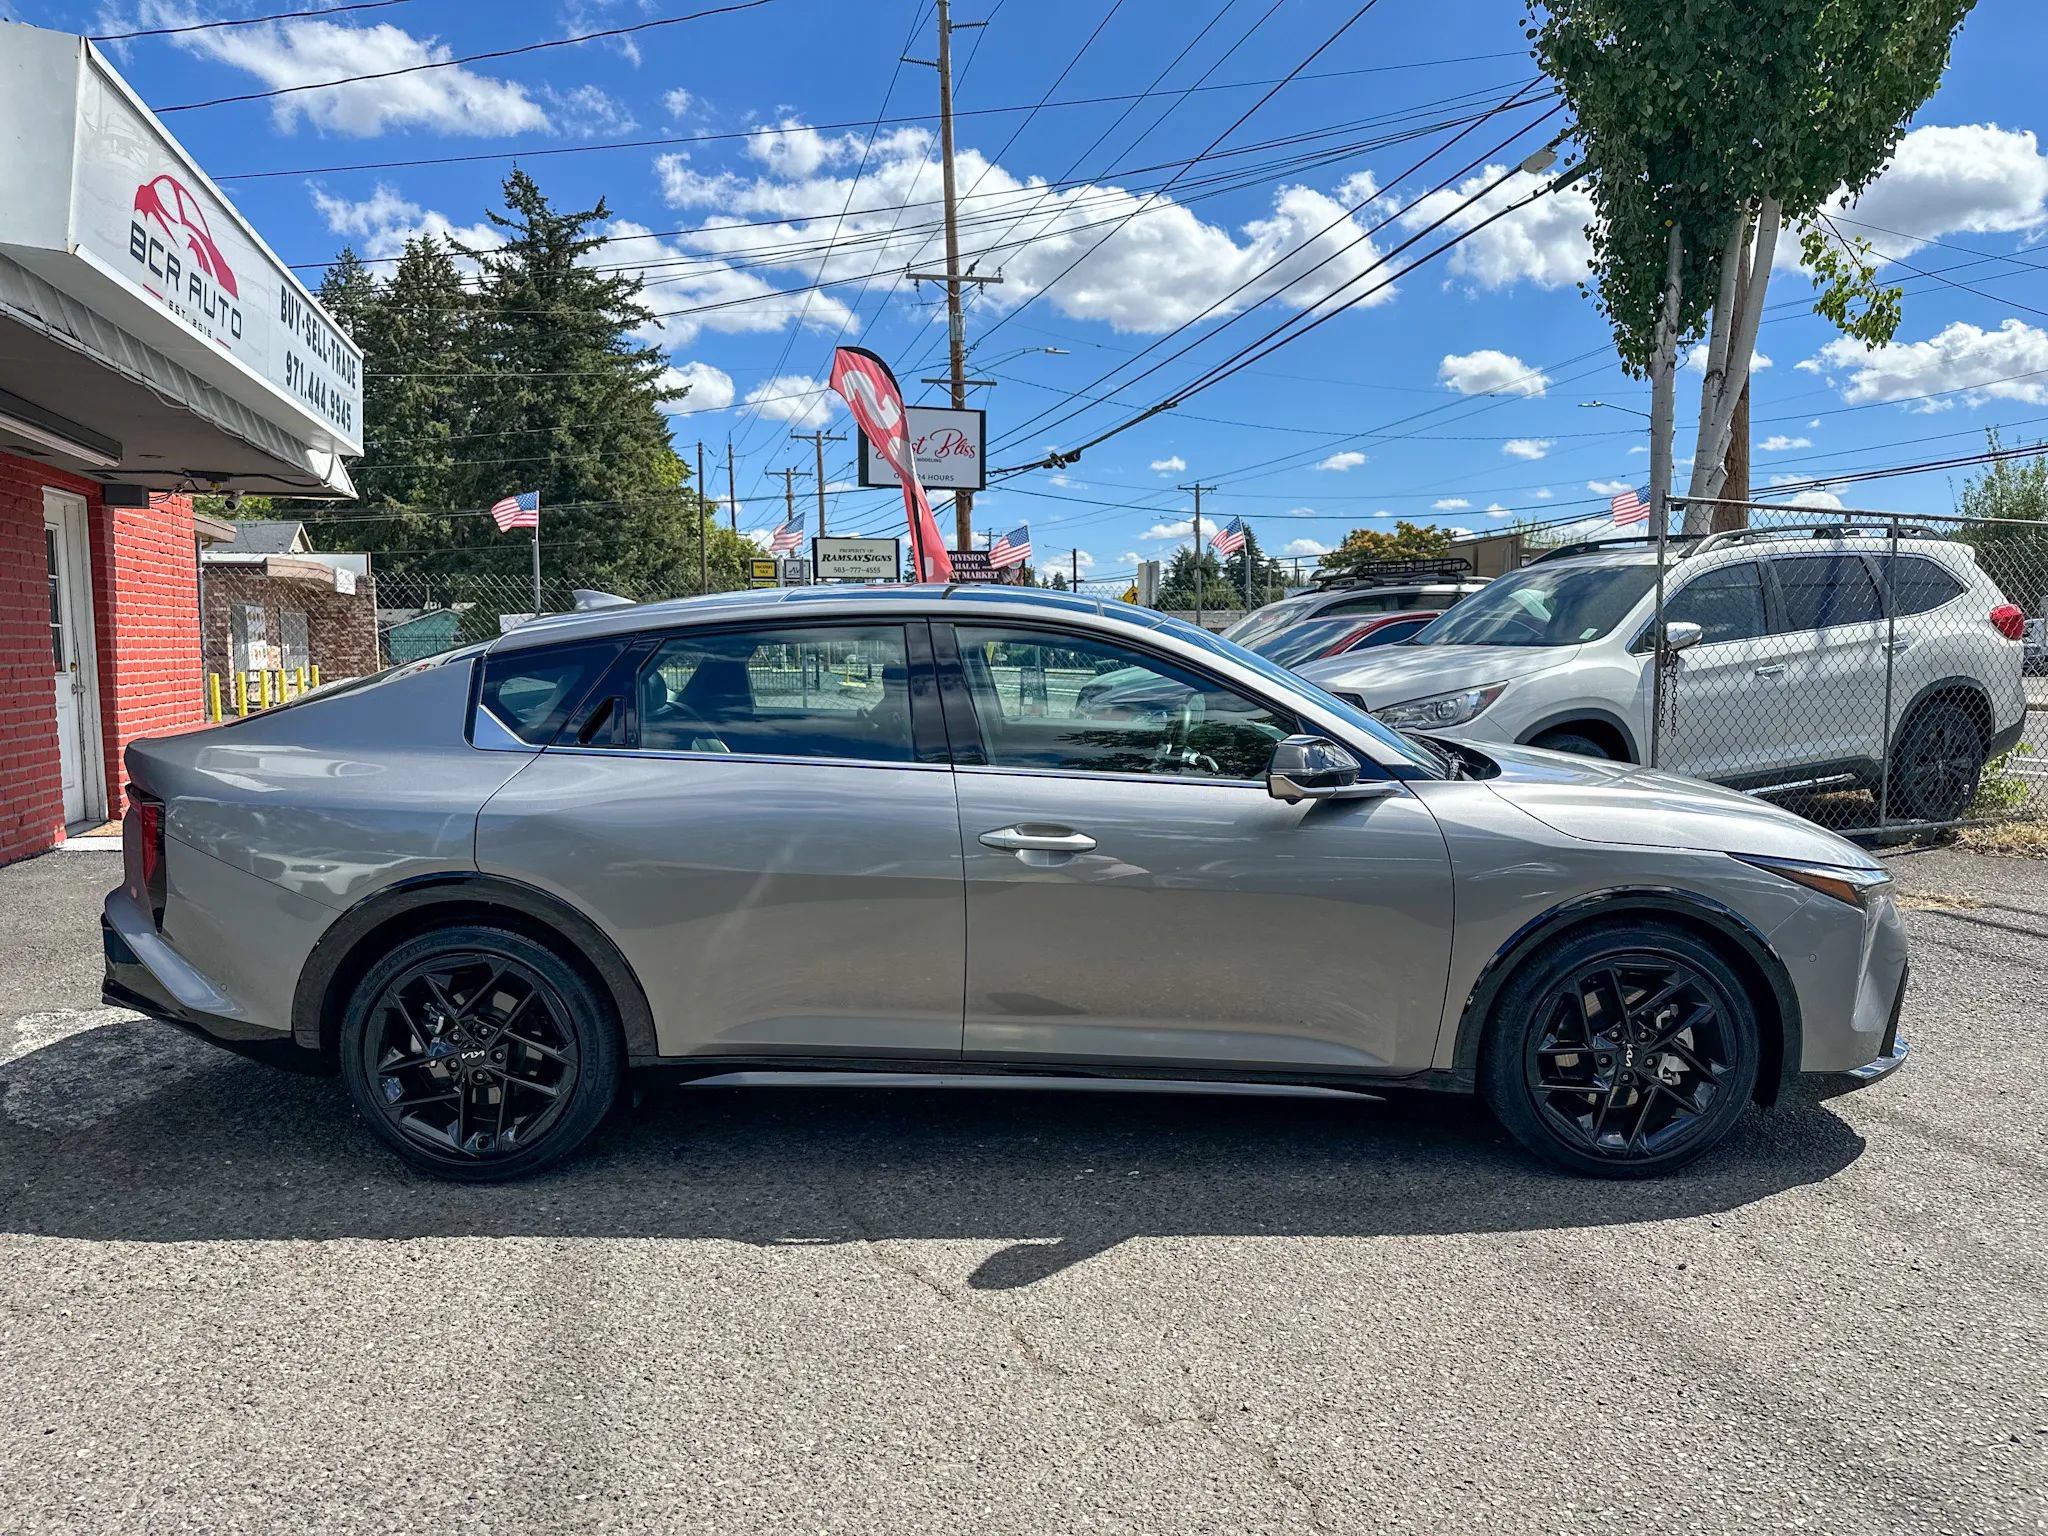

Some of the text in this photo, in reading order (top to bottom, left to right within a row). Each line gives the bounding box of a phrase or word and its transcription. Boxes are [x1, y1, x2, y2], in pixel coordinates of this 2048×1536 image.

[130, 220, 242, 340] BCR AUTO
[286, 350, 351, 432] 971.444.9945
[930, 428, 976, 459] Bliss
[949, 553, 986, 561] DIVISION
[962, 571, 999, 579] MARKET
